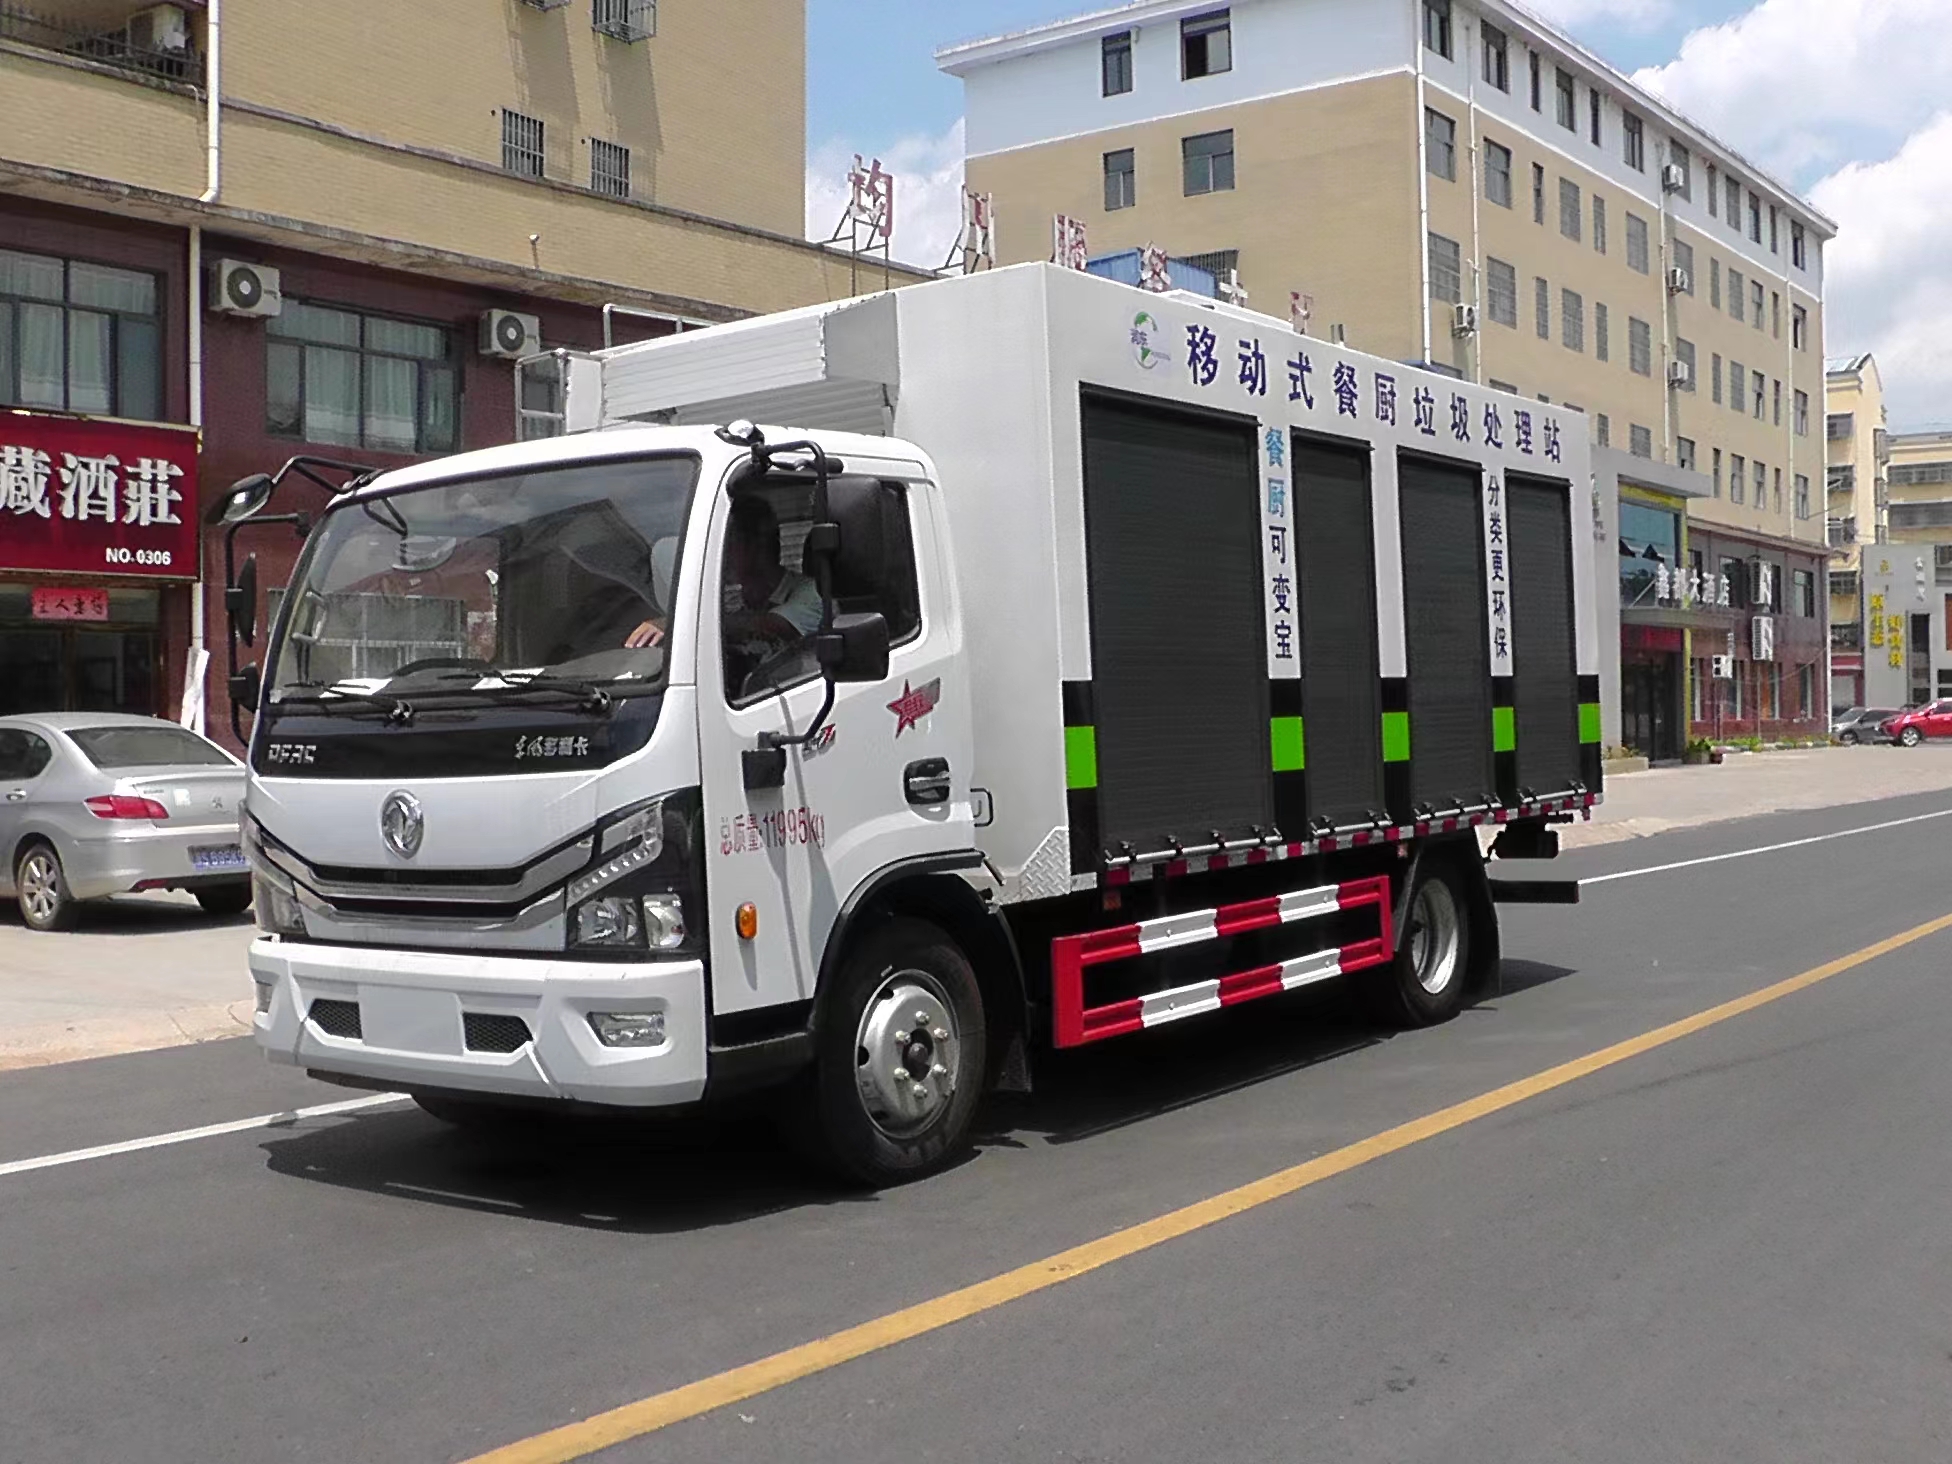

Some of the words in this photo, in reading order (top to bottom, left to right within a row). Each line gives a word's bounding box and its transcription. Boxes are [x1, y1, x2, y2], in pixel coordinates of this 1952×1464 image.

[1186, 323, 1561, 464] 移动式餐厨垃圾处理站
[0, 445, 184, 526] 藏酒莊
[1264, 426, 1293, 660] 餐厨可变宝
[105, 547, 171, 566] NO.0306
[1487, 475, 1508, 660] 分类更环保
